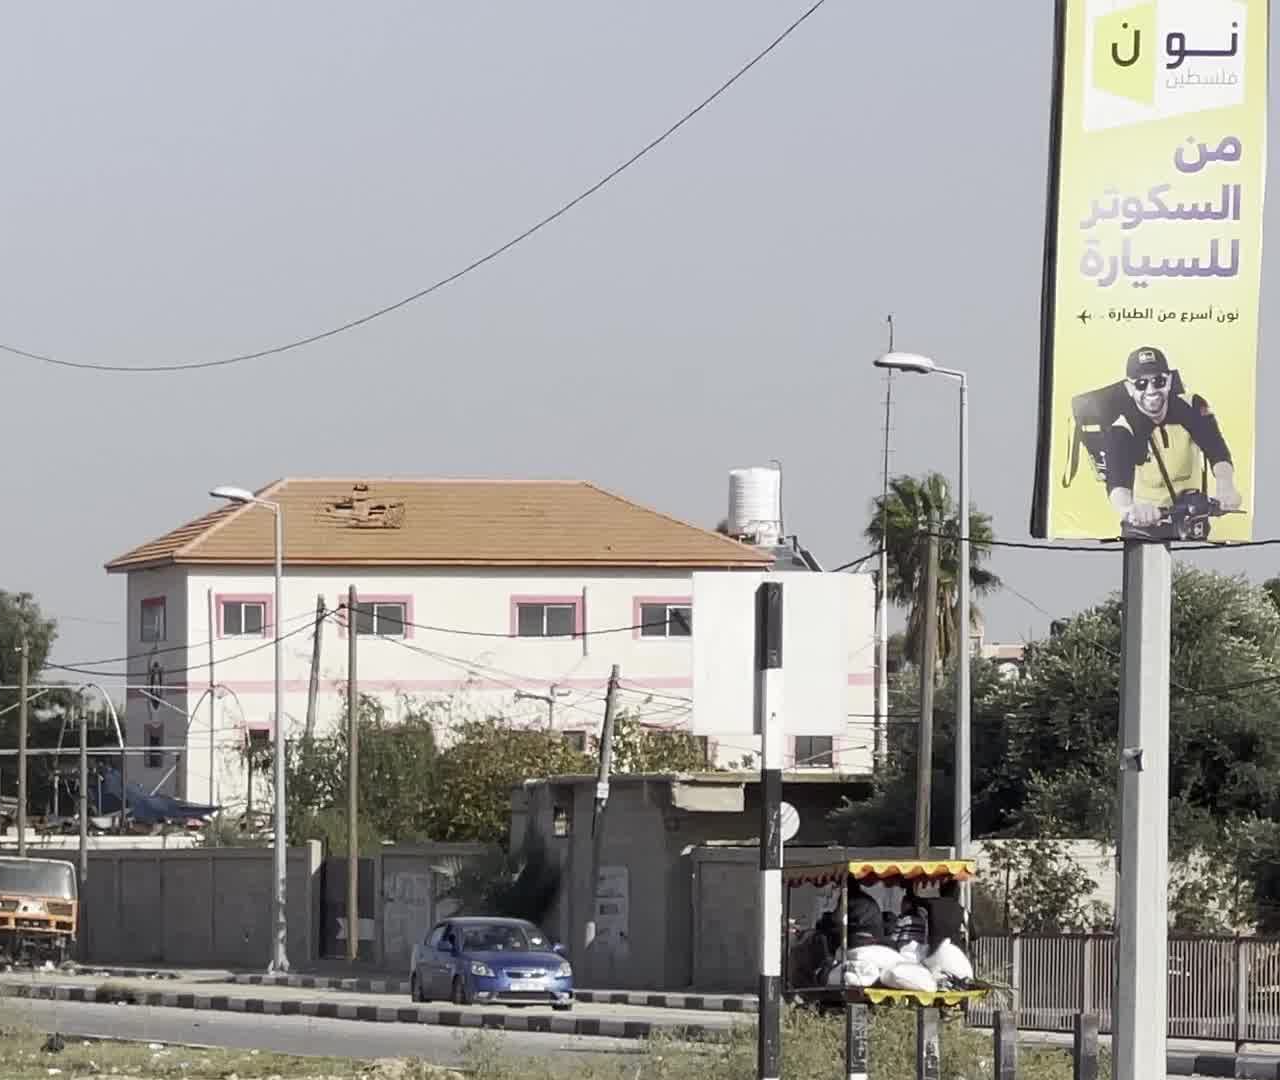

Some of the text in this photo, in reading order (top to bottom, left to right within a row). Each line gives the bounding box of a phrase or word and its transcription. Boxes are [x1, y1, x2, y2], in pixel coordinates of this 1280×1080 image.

[1165, 67, 1238, 89] فلسطين
[1173, 135, 1243, 174] من
[1079, 183, 1242, 230] السكوتر
[1079, 238, 1241, 288] للسيارة
[1157, 309, 1177, 323] من
[1179, 305, 1213, 322] أسرع
[1216, 308, 1239, 323] نون
